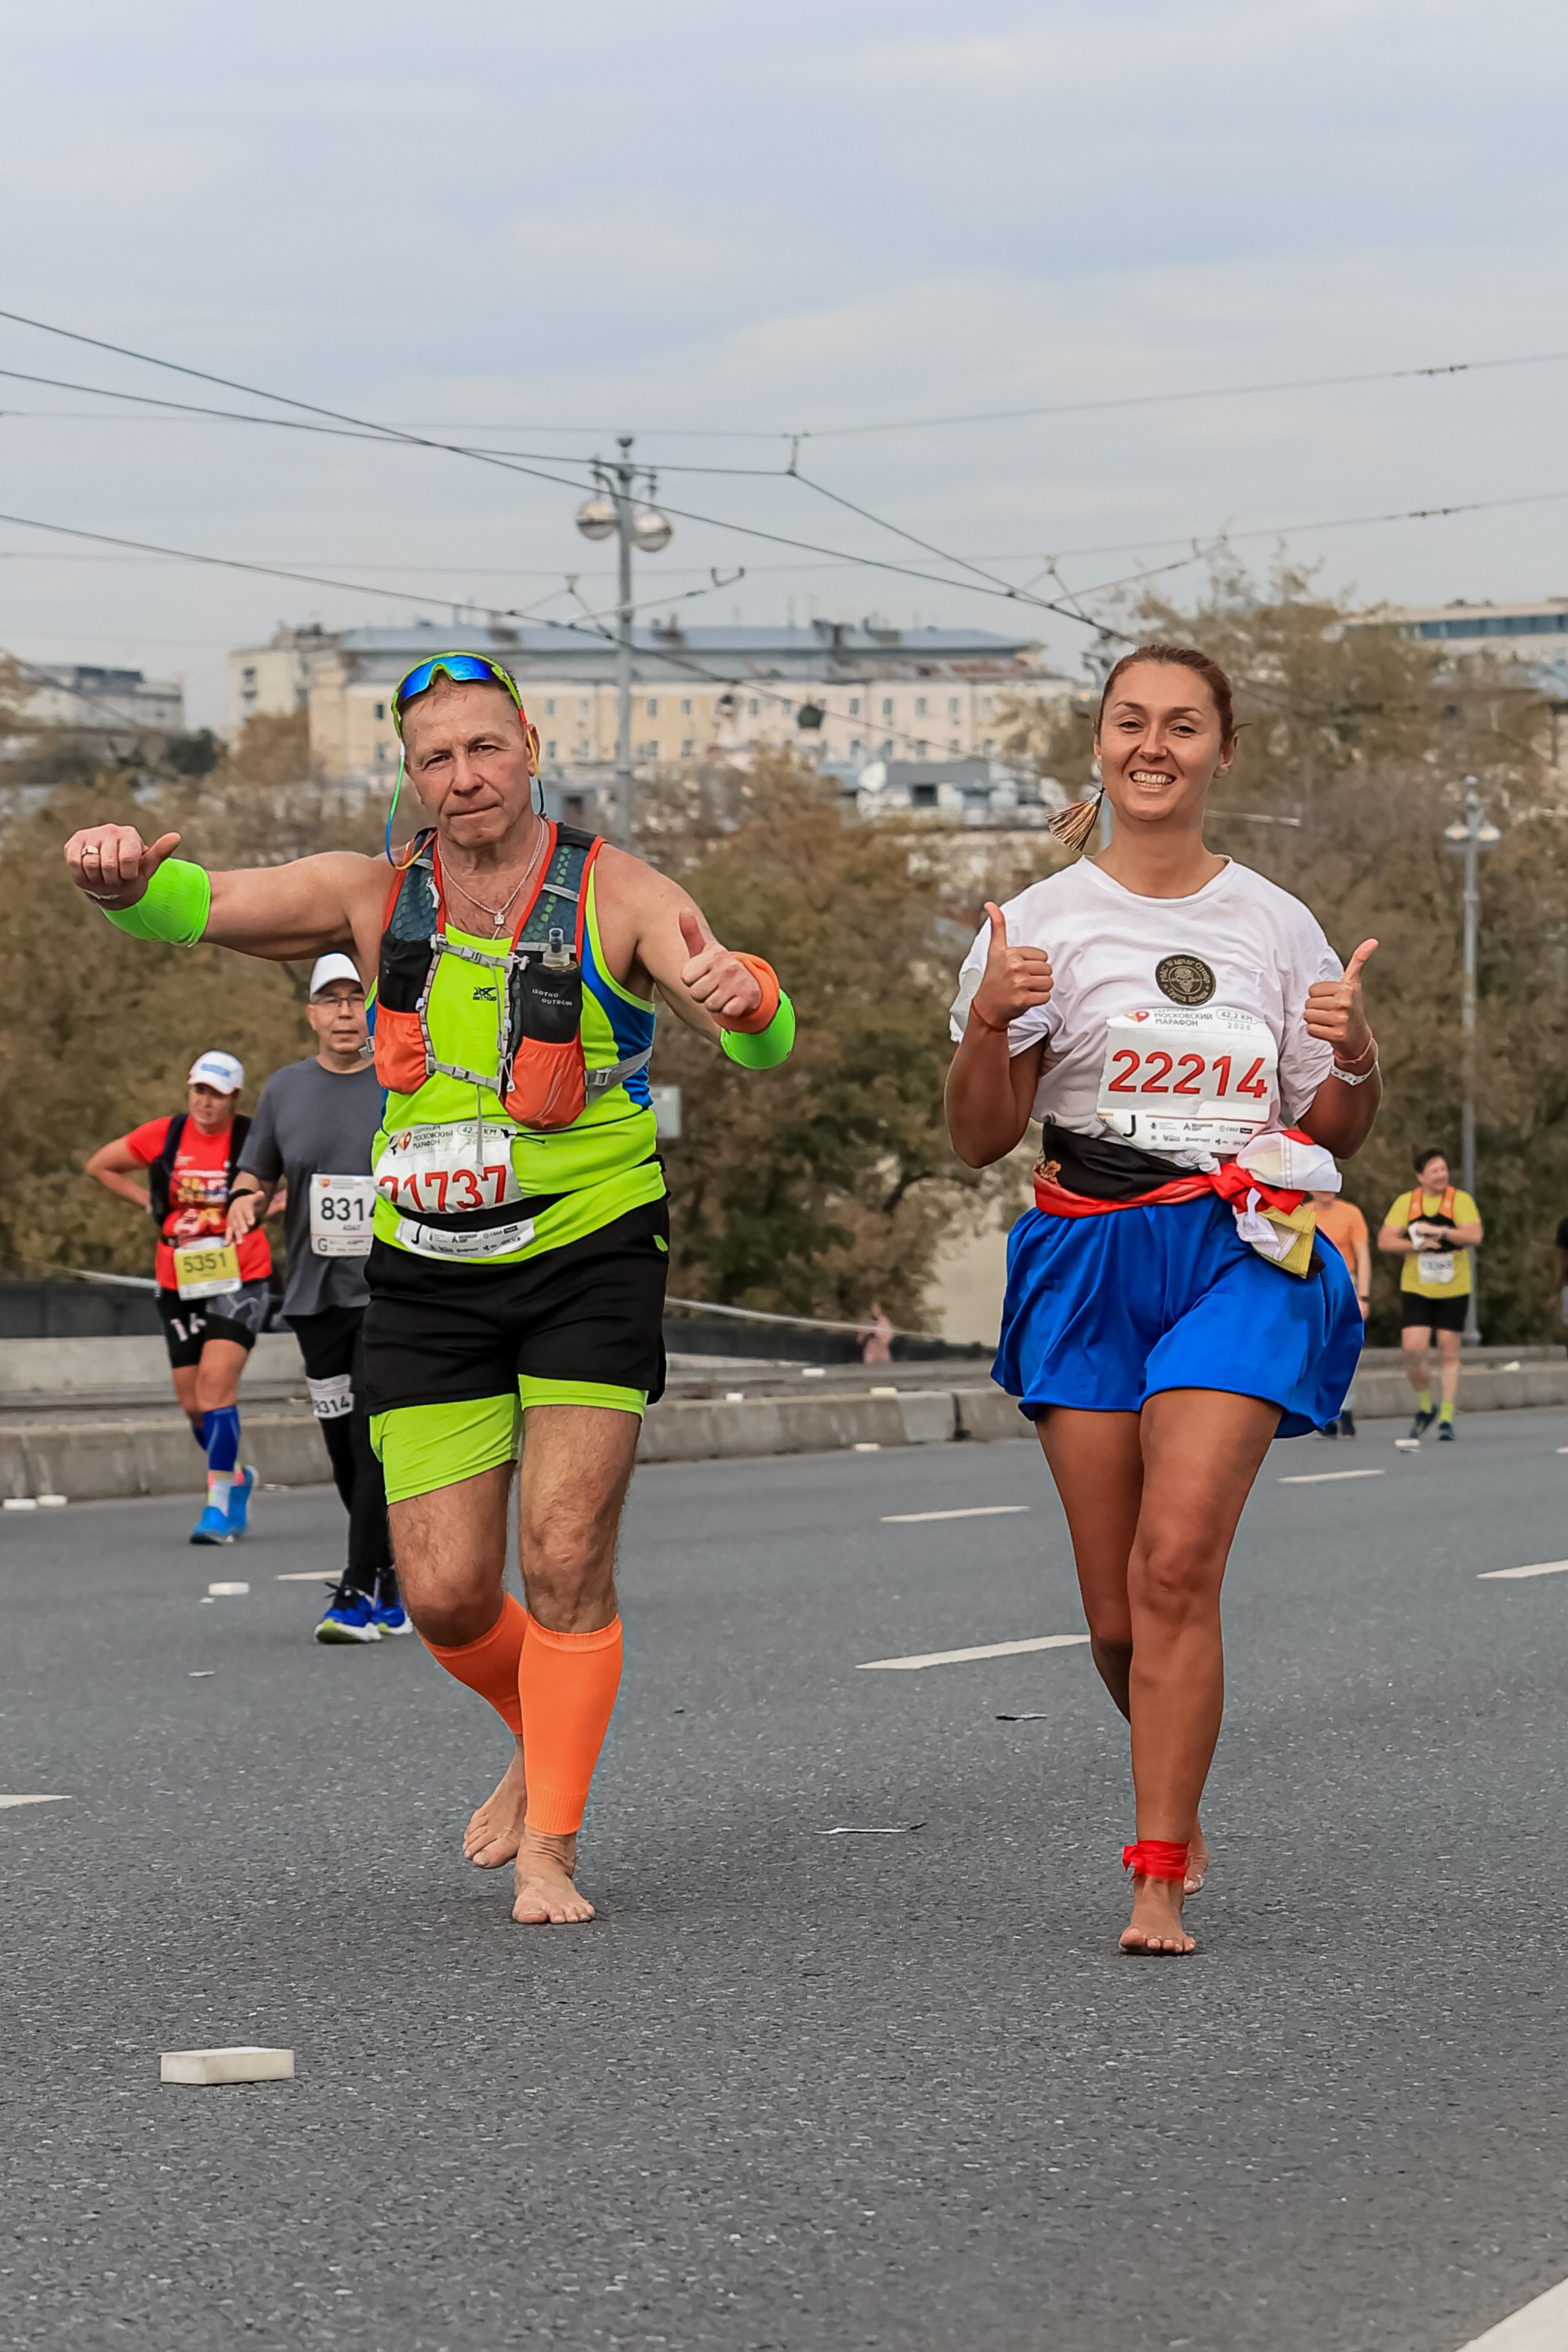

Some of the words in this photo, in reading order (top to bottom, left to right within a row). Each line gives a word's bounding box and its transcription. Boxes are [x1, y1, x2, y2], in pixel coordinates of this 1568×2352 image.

[1154, 1012, 1213, 1021] МОСКОВСКИЙ
[1108, 1049, 1269, 1098] 22214
[1123, 1114, 1137, 1138] J
[412, 1138, 441, 1150] МАРАФОН
[318, 1237, 328, 1252] G
[183, 1252, 227, 1273] 5351
